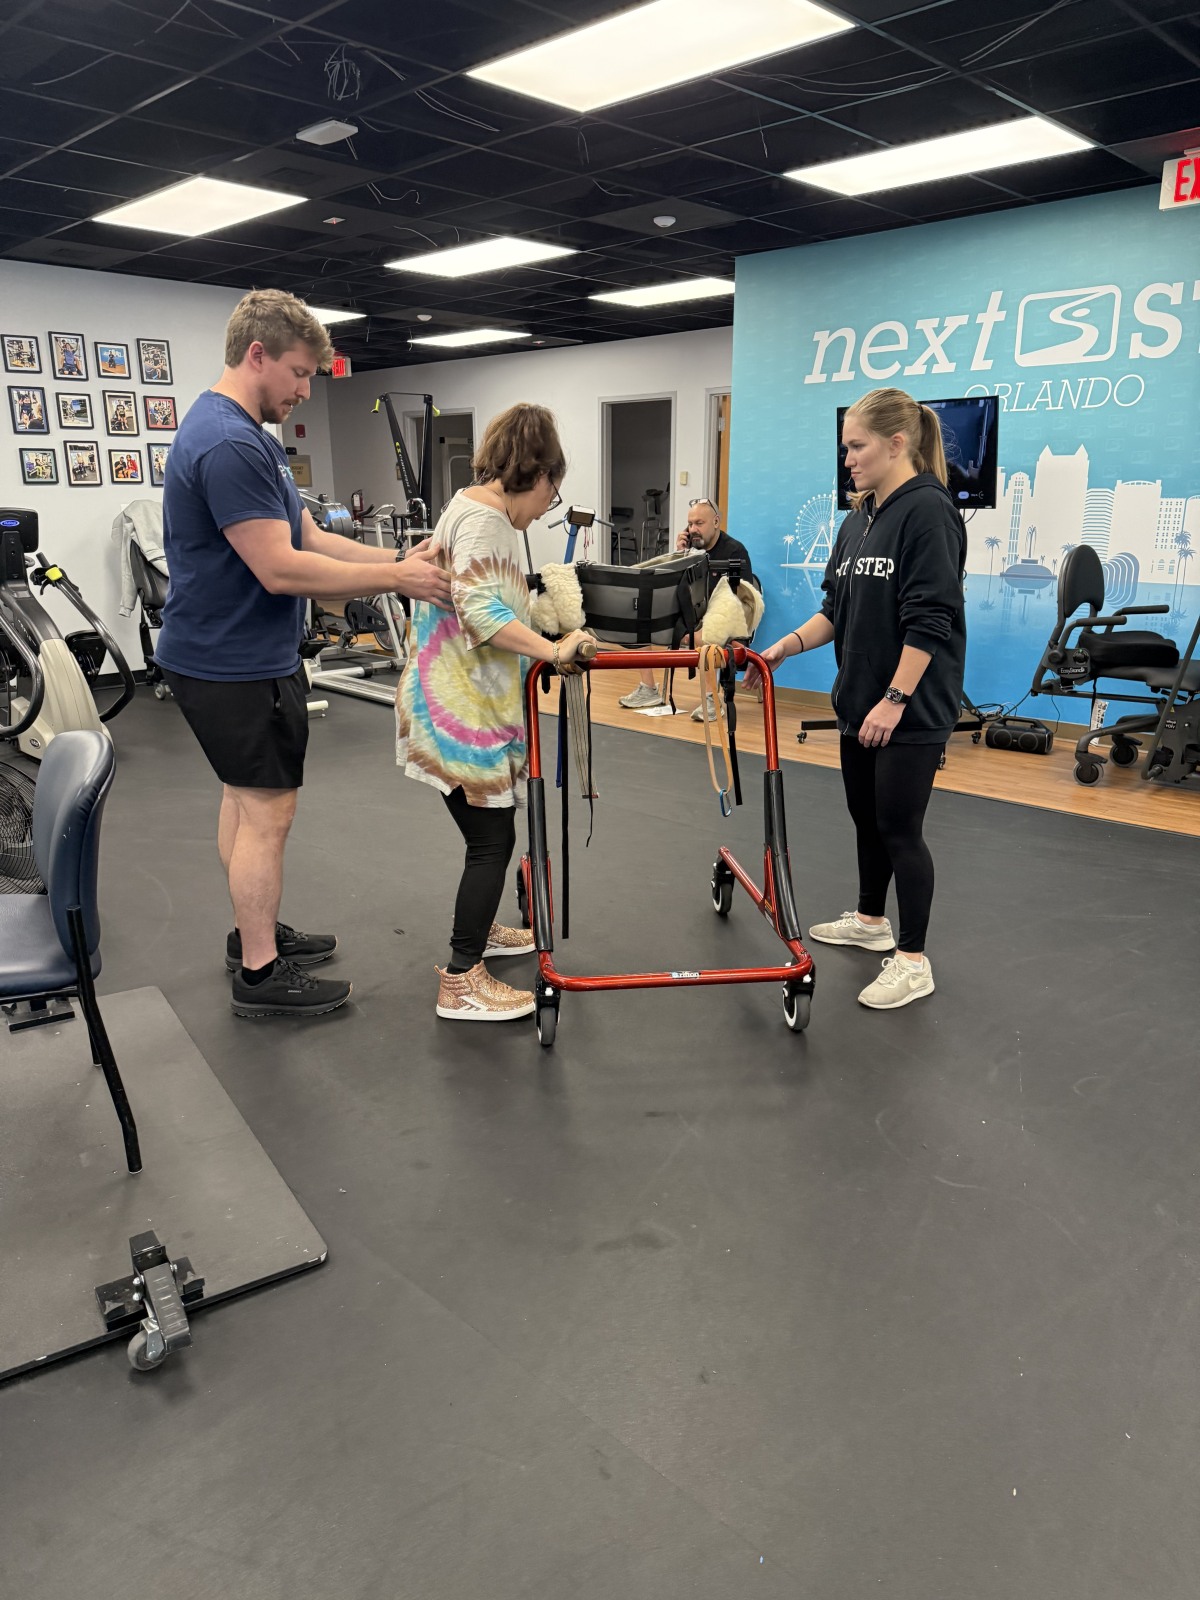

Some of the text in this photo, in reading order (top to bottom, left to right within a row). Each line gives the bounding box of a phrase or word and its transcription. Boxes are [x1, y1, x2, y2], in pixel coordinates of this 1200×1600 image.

[804, 280, 1200, 385] next S
[855, 557, 895, 580] STEP
